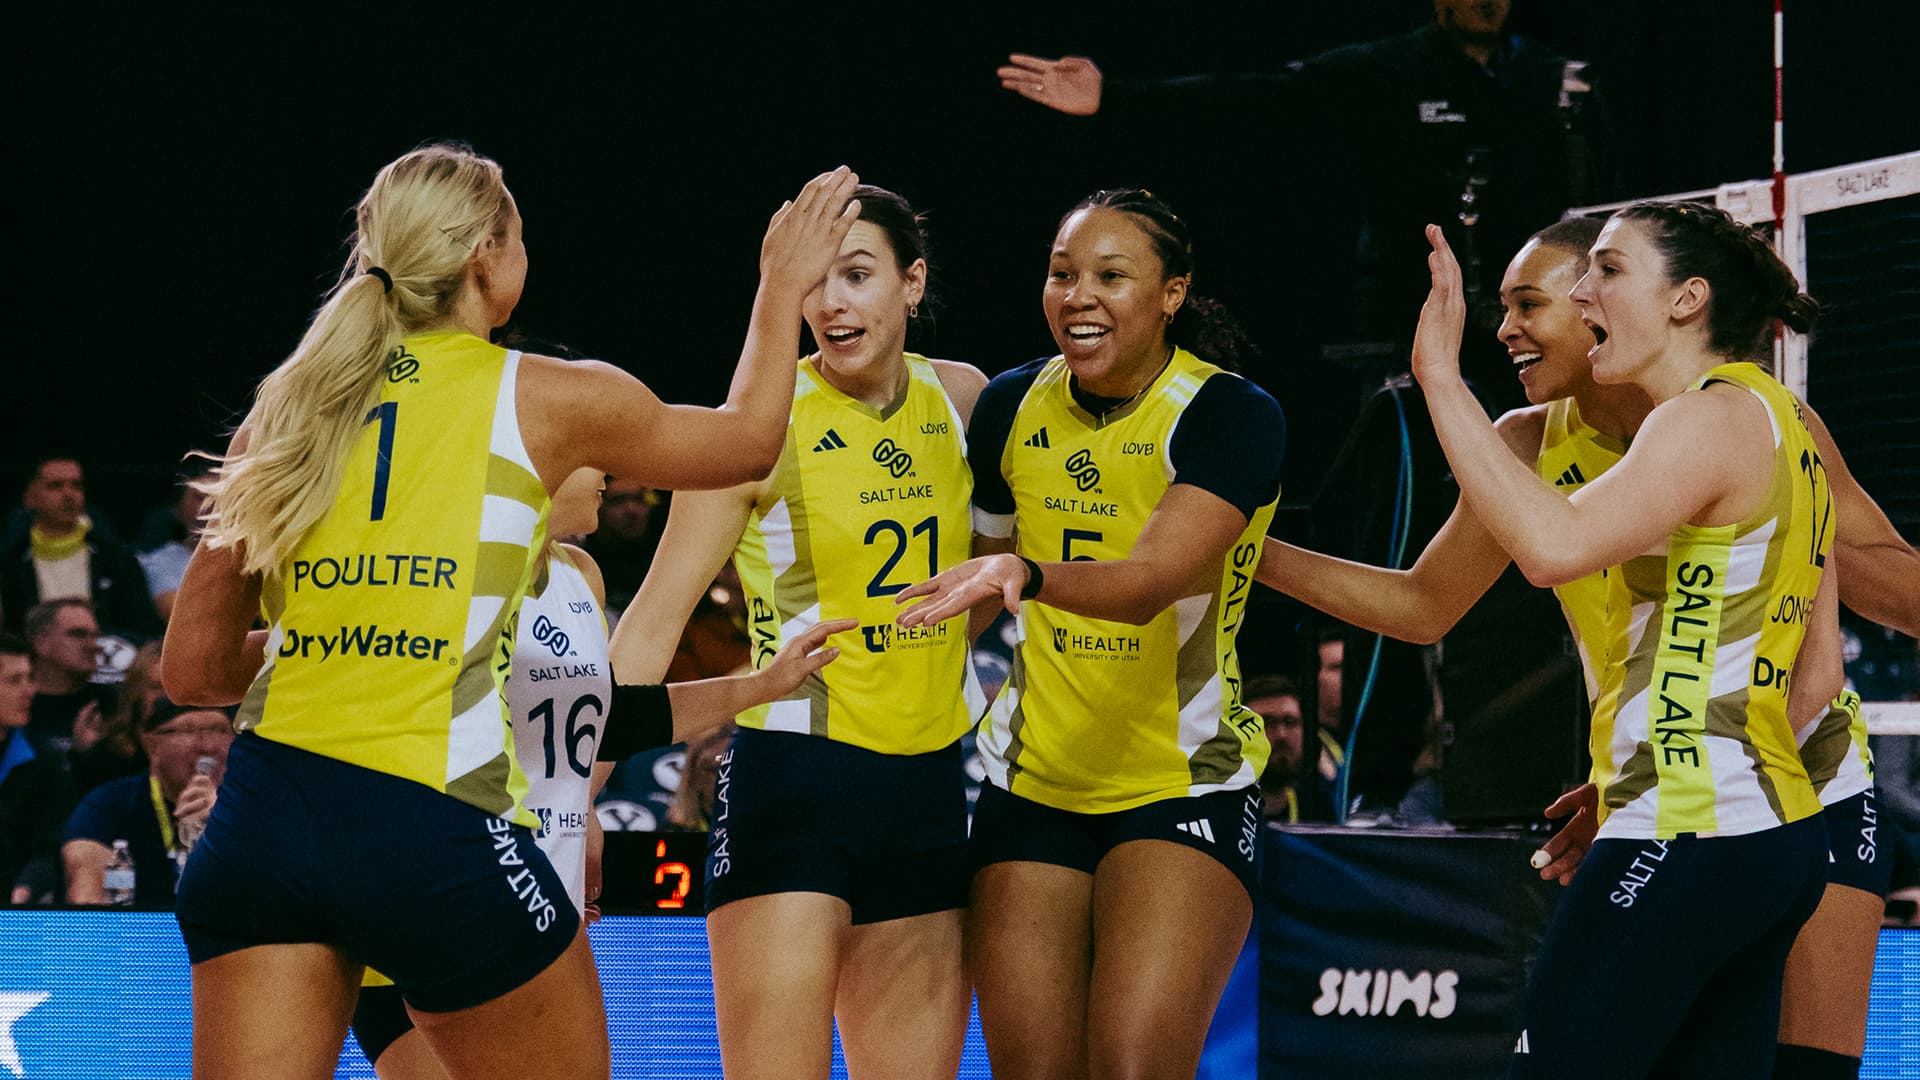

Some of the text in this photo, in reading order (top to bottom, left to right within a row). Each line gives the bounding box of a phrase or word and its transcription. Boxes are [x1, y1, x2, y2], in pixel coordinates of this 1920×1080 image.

[920, 422, 949, 435] LOVB
[1122, 442, 1154, 456] LOVB
[363, 401, 399, 522] 1
[859, 484, 933, 504] SALT LAKE
[1044, 496, 1119, 517] SALT LAKE
[864, 516, 938, 597] 21
[1061, 528, 1103, 561] 5
[293, 554, 458, 593] POULTER
[1771, 595, 1812, 626] JON
[1072, 634, 1140, 652] HEALTH
[1655, 562, 1714, 768] SALT LAKE
[529, 663, 599, 682] SALT LAKE
[528, 693, 603, 779] 16
[718, 749, 735, 822] LAKE
[486, 817, 524, 866] AKE
[559, 812, 588, 828] HEAL
[1238, 801, 1257, 863] SALT
[1857, 799, 1878, 864] SALT
[1610, 839, 1673, 908] SALT LA
[507, 867, 557, 932] SALT
[1312, 967, 1459, 1019] SKIMS
